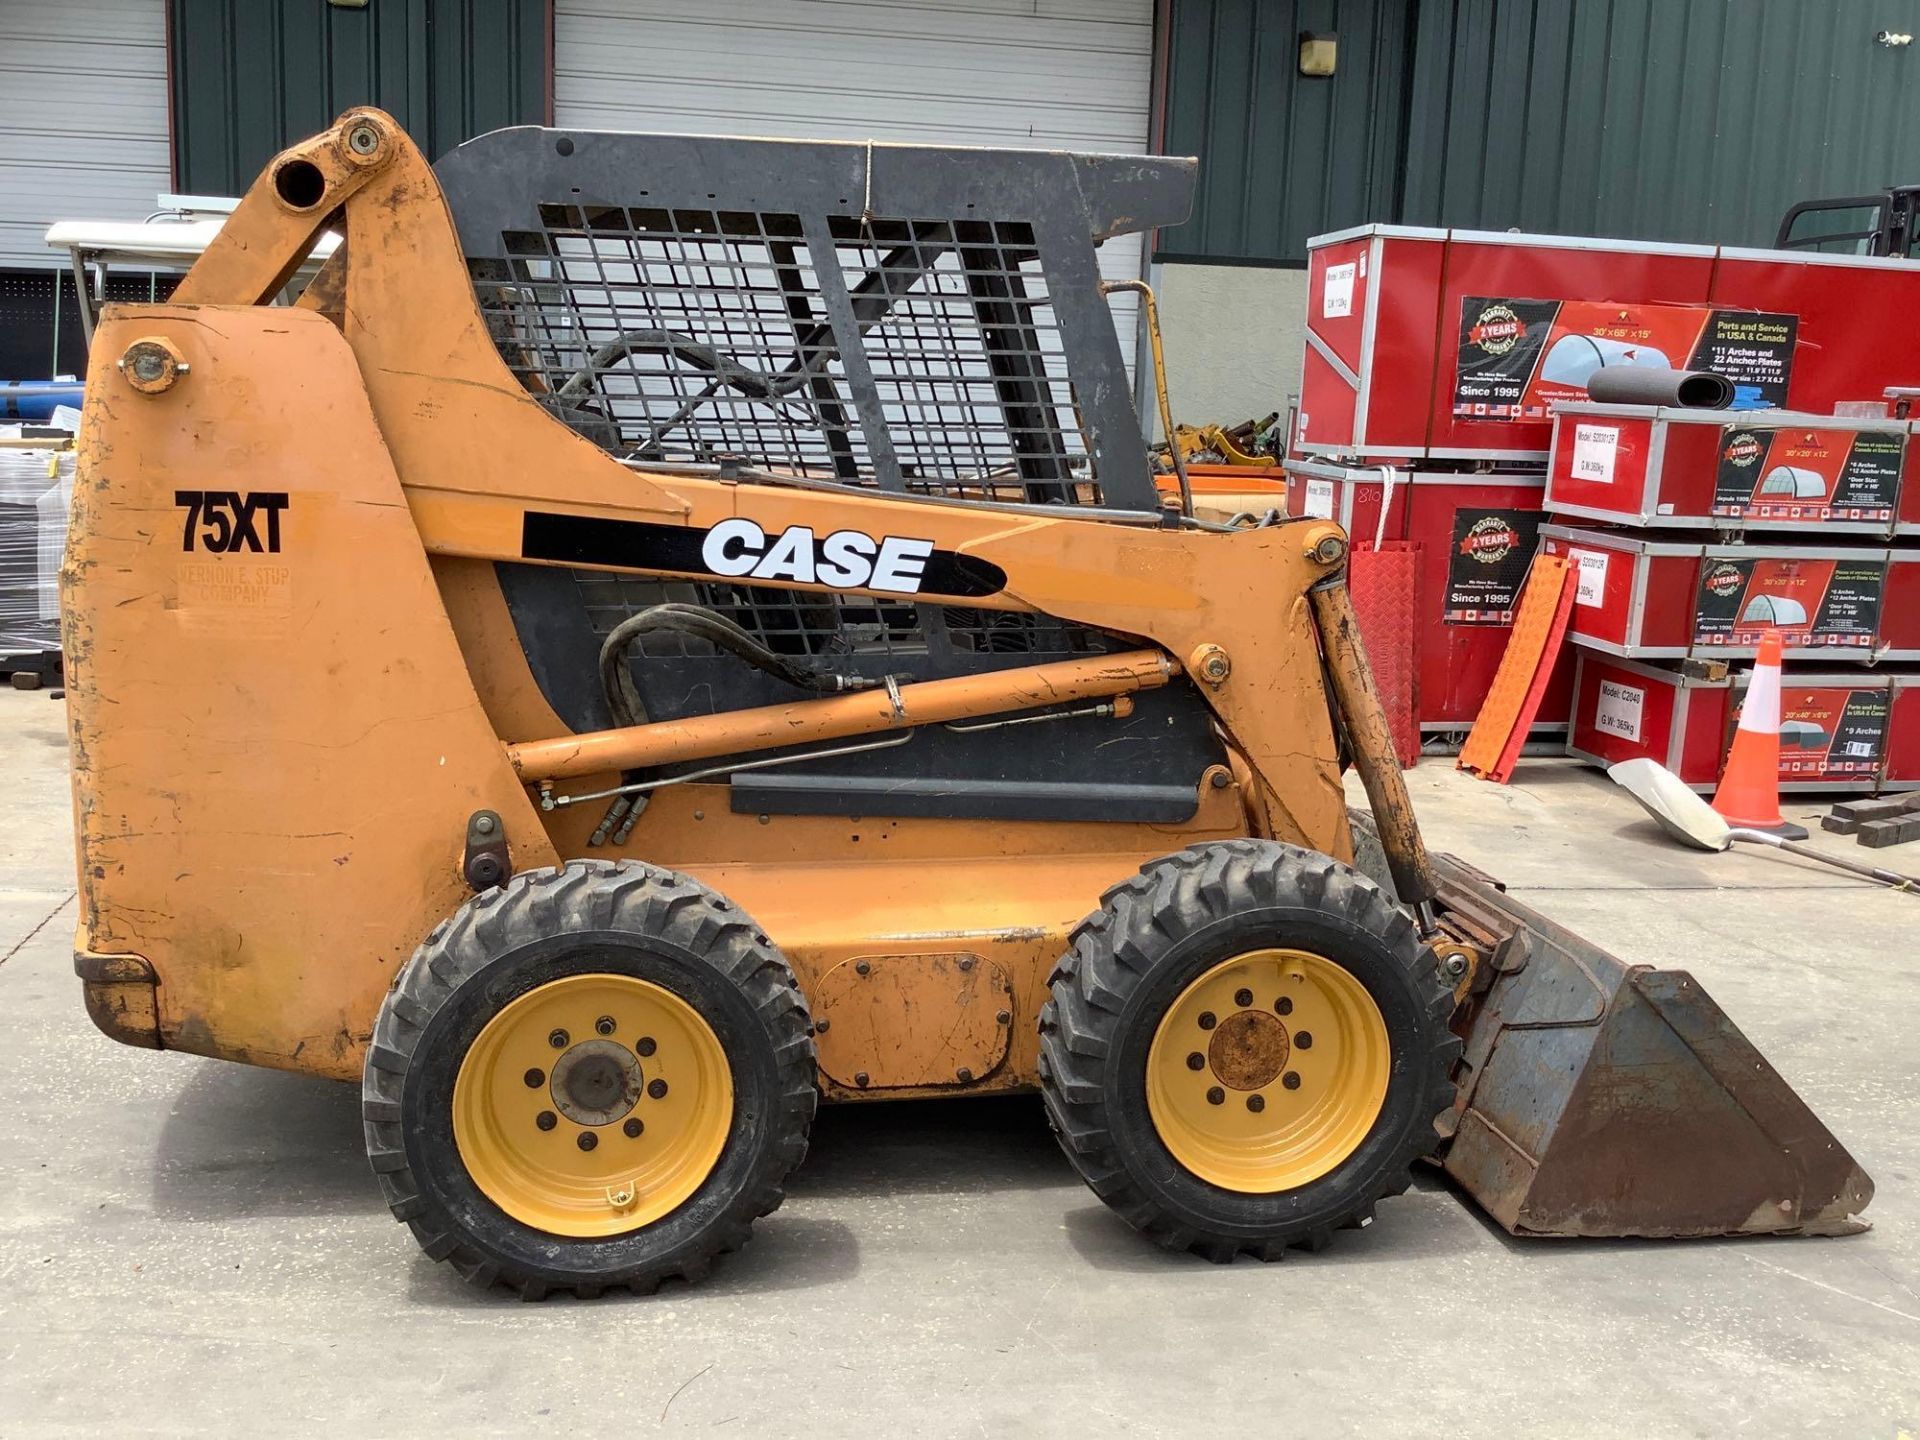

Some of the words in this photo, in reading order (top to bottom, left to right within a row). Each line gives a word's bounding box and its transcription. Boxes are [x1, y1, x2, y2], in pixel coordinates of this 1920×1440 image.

[1483, 308, 1512, 321] WARRANTY
[1480, 328, 1486, 337] 2
[1487, 323, 1517, 336] YEARS
[1717, 321, 1738, 330] Parts
[1740, 323, 1756, 331] and
[1758, 324, 1789, 333] Service
[1716, 331, 1725, 339] in
[1726, 332, 1746, 340] USA
[1747, 332, 1754, 340] &
[1756, 333, 1786, 342] Canada
[1484, 338, 1512, 350] WARRANTY
[1727, 348, 1756, 356] Arches
[1758, 350, 1774, 358] and
[1714, 356, 1724, 364] 22
[1726, 356, 1756, 365] Anchor
[1758, 358, 1782, 366] Plates
[1460, 386, 1490, 396] Since
[1494, 387, 1520, 398] 1995
[1737, 446, 1758, 454] YEARS
[174, 490, 290, 554] 75XT
[1475, 519, 1503, 532] WARRANTY
[1472, 538, 1478, 548] 2
[1479, 534, 1510, 546] YEARS
[702, 517, 935, 594] CASE
[1476, 548, 1504, 560] WARRANTY
[180, 564, 234, 584] VERNON
[1718, 575, 1739, 584] YEARS
[200, 584, 269, 603] COMPANY
[1451, 593, 1480, 602] Since
[1484, 594, 1510, 604] 1995
[1602, 684, 1620, 698] Model:
[1622, 690, 1640, 704] C2040
